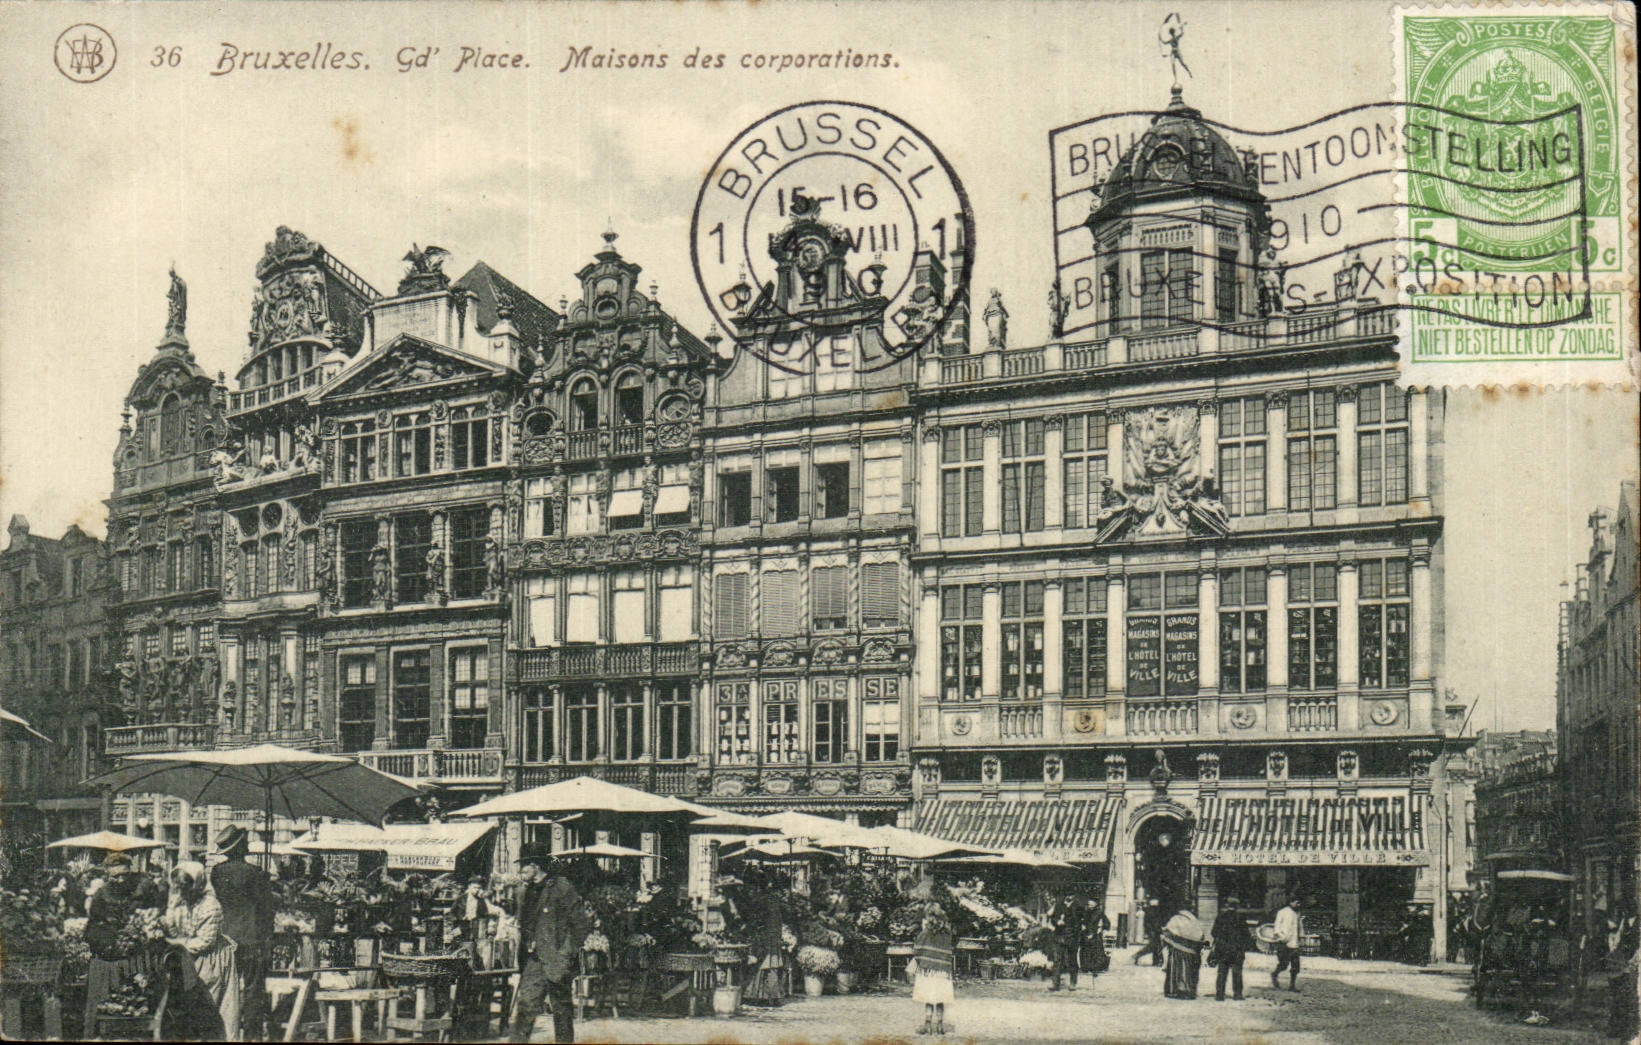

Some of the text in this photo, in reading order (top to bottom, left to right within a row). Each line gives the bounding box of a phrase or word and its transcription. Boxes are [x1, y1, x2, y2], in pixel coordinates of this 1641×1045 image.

[1475, 23, 1546, 38] POSTES
[1418, 81, 1438, 189] BELGIQUE
[1417, 328, 1619, 356] NIET BESTELLEN OP ZONDAG.
[1128, 629, 1160, 639] MAGASINS
[1166, 632, 1198, 641] MAGASINS
[1129, 668, 1160, 680] VILLE
[1167, 670, 1198, 683] VILLE
[1358, 810, 1423, 833] VILLE
[1328, 852, 1387, 863] VILLE
